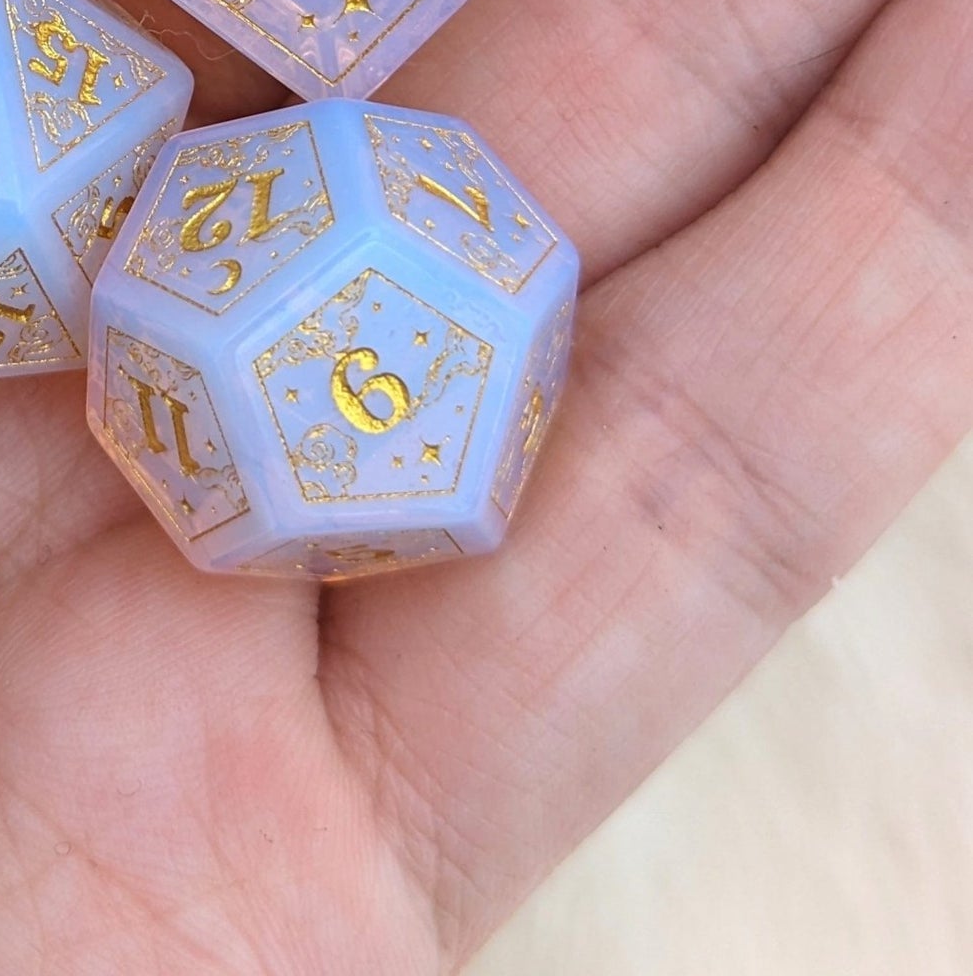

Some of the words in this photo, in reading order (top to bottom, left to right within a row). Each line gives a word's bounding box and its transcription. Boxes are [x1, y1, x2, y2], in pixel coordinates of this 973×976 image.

[29, 17, 110, 106] 15
[179, 168, 284, 253] 12
[416, 174, 494, 232] 7
[129, 376, 201, 477] 11
